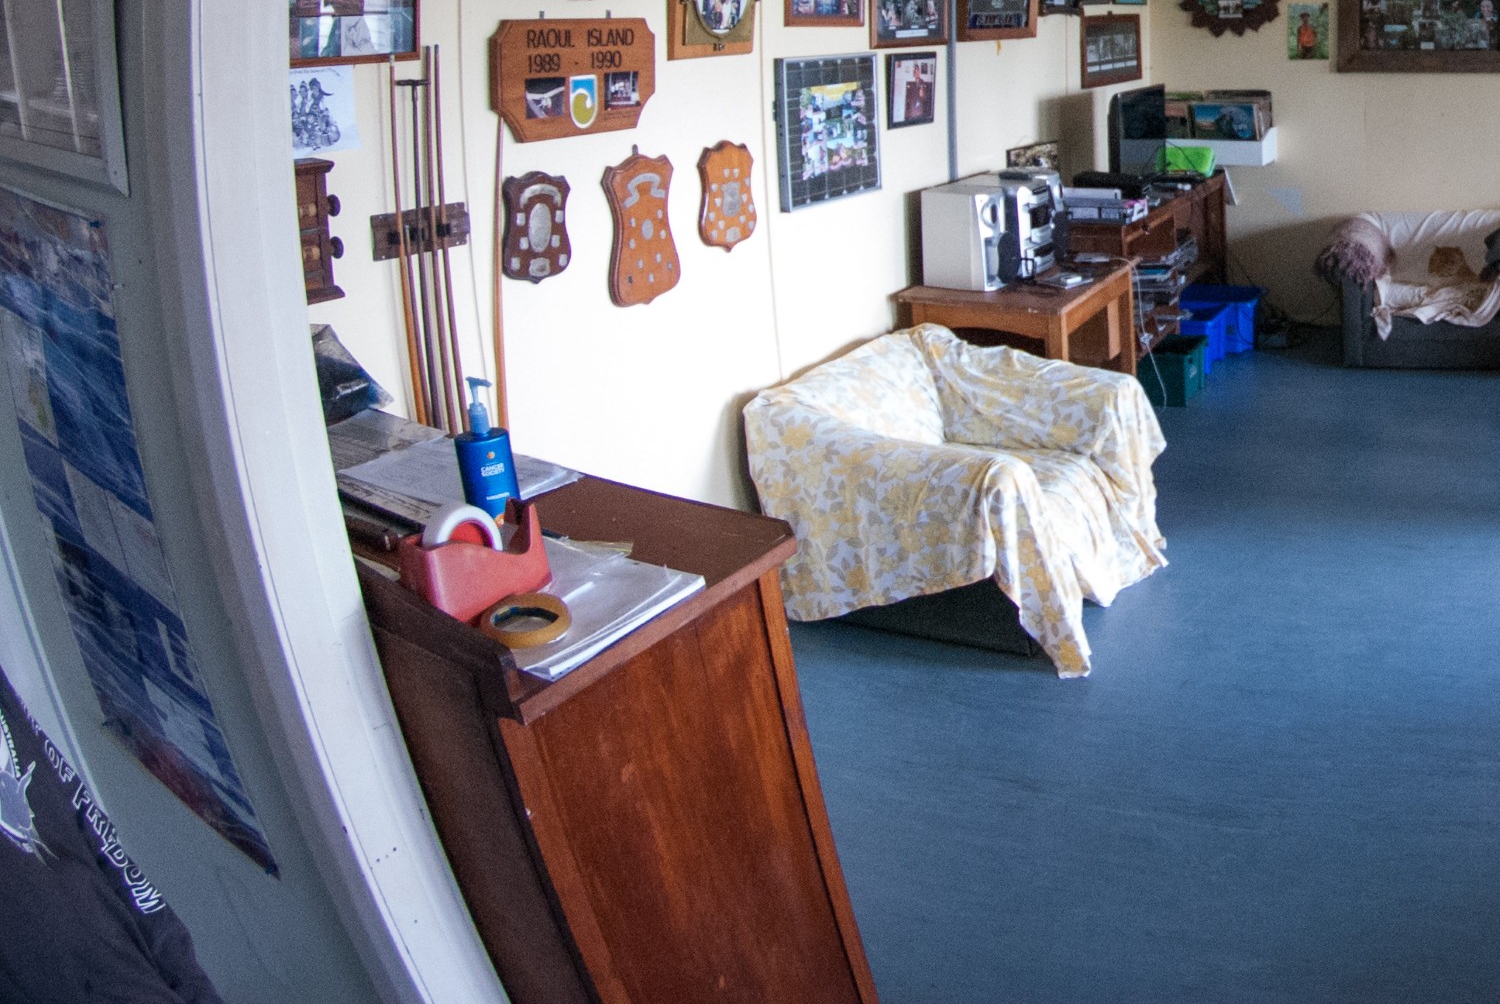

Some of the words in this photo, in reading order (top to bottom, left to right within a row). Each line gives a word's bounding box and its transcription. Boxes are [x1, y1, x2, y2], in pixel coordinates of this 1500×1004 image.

[527, 29, 574, 49] RAOUL
[587, 28, 635, 47] ISLAND
[528, 53, 561, 73] 1989
[590, 50, 622, 69] 1990
[481, 463, 504, 472] CANCER
[481, 468, 505, 477] SOCIETY
[44, 739, 76, 783] OF
[71, 781, 167, 914] FREDOM
